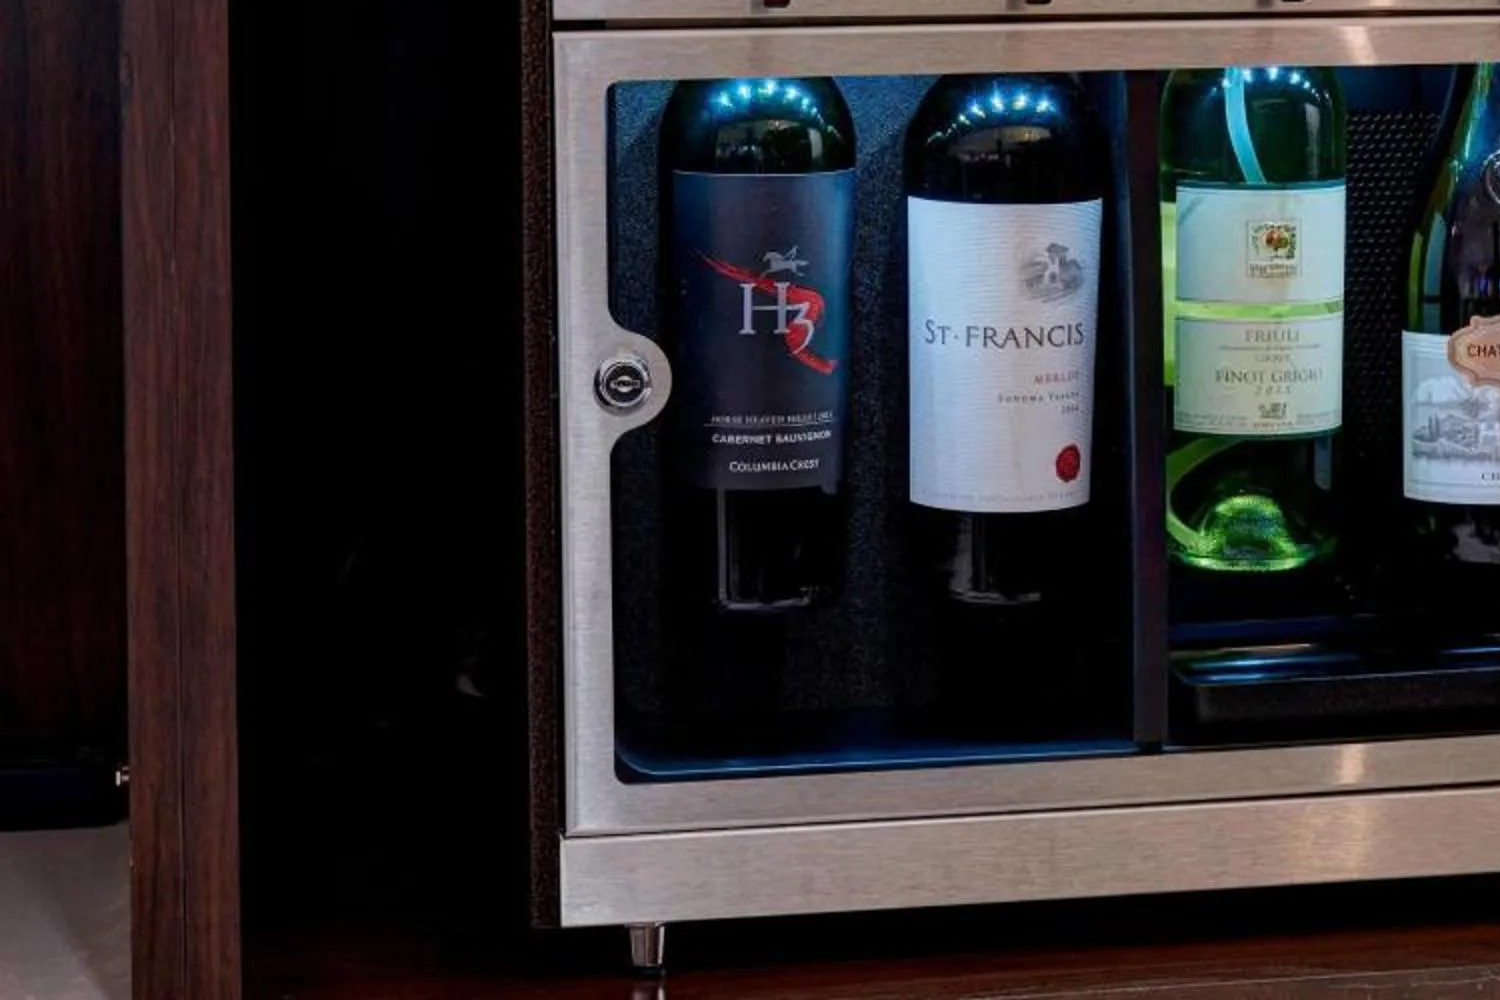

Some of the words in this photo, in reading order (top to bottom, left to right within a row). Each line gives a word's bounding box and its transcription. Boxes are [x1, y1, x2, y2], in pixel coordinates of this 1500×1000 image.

[966, 322, 1085, 349] FRANCIS
[1215, 368, 1266, 384] PINOT
[711, 432, 771, 446] CABERNET
